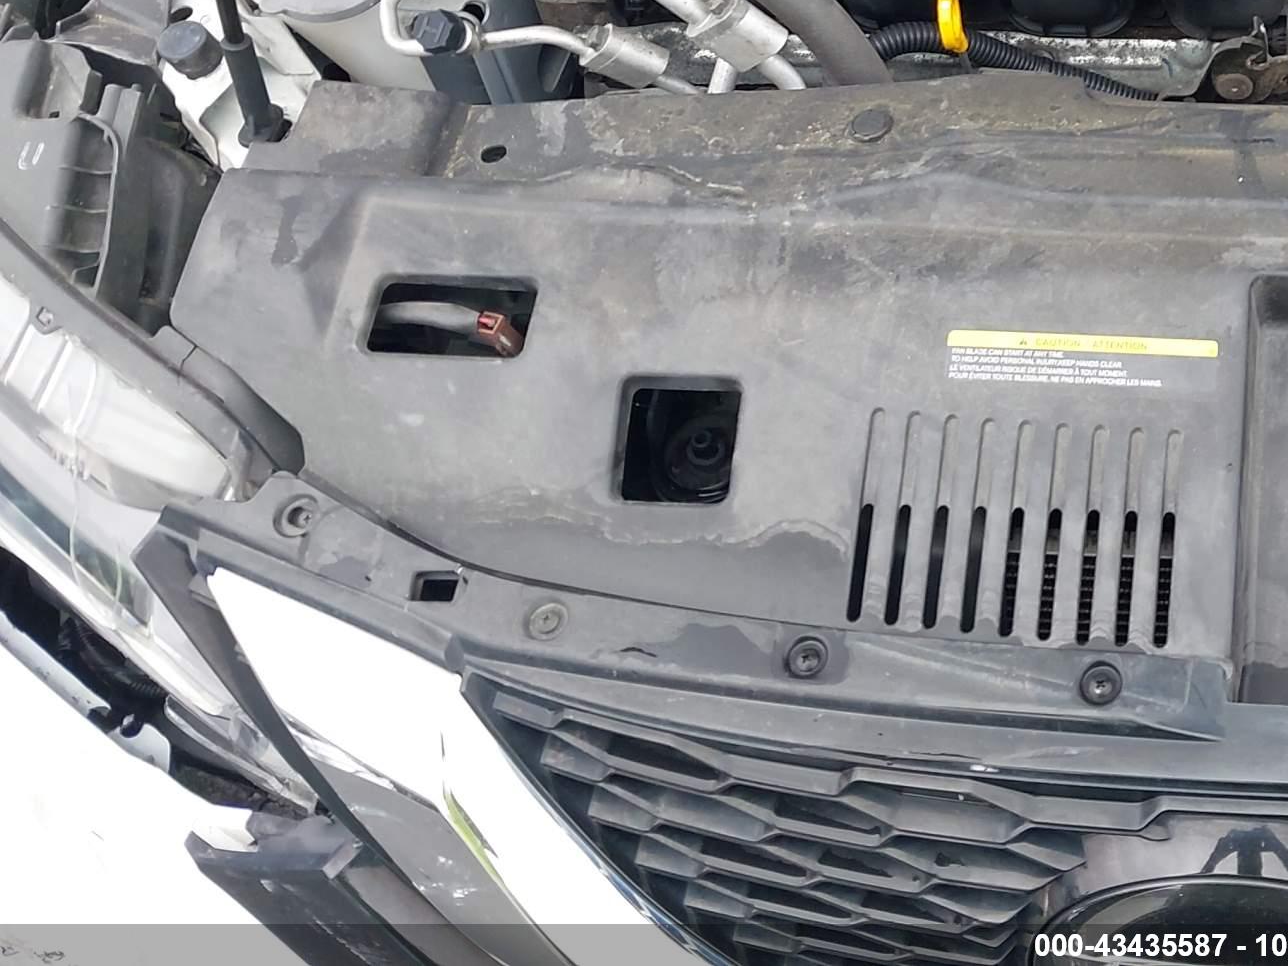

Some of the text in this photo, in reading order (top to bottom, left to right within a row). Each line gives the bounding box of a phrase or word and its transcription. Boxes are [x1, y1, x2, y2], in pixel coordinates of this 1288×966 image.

[1036, 338, 1146, 349] CAUTION ATTENTION
[978, 355, 1000, 363] AVOID
[1000, 356, 1033, 364] PERSONAL
[959, 364, 1000, 372] VENTILATEUR
[1001, 365, 1026, 373] RISQUE
[948, 371, 968, 379] POUR
